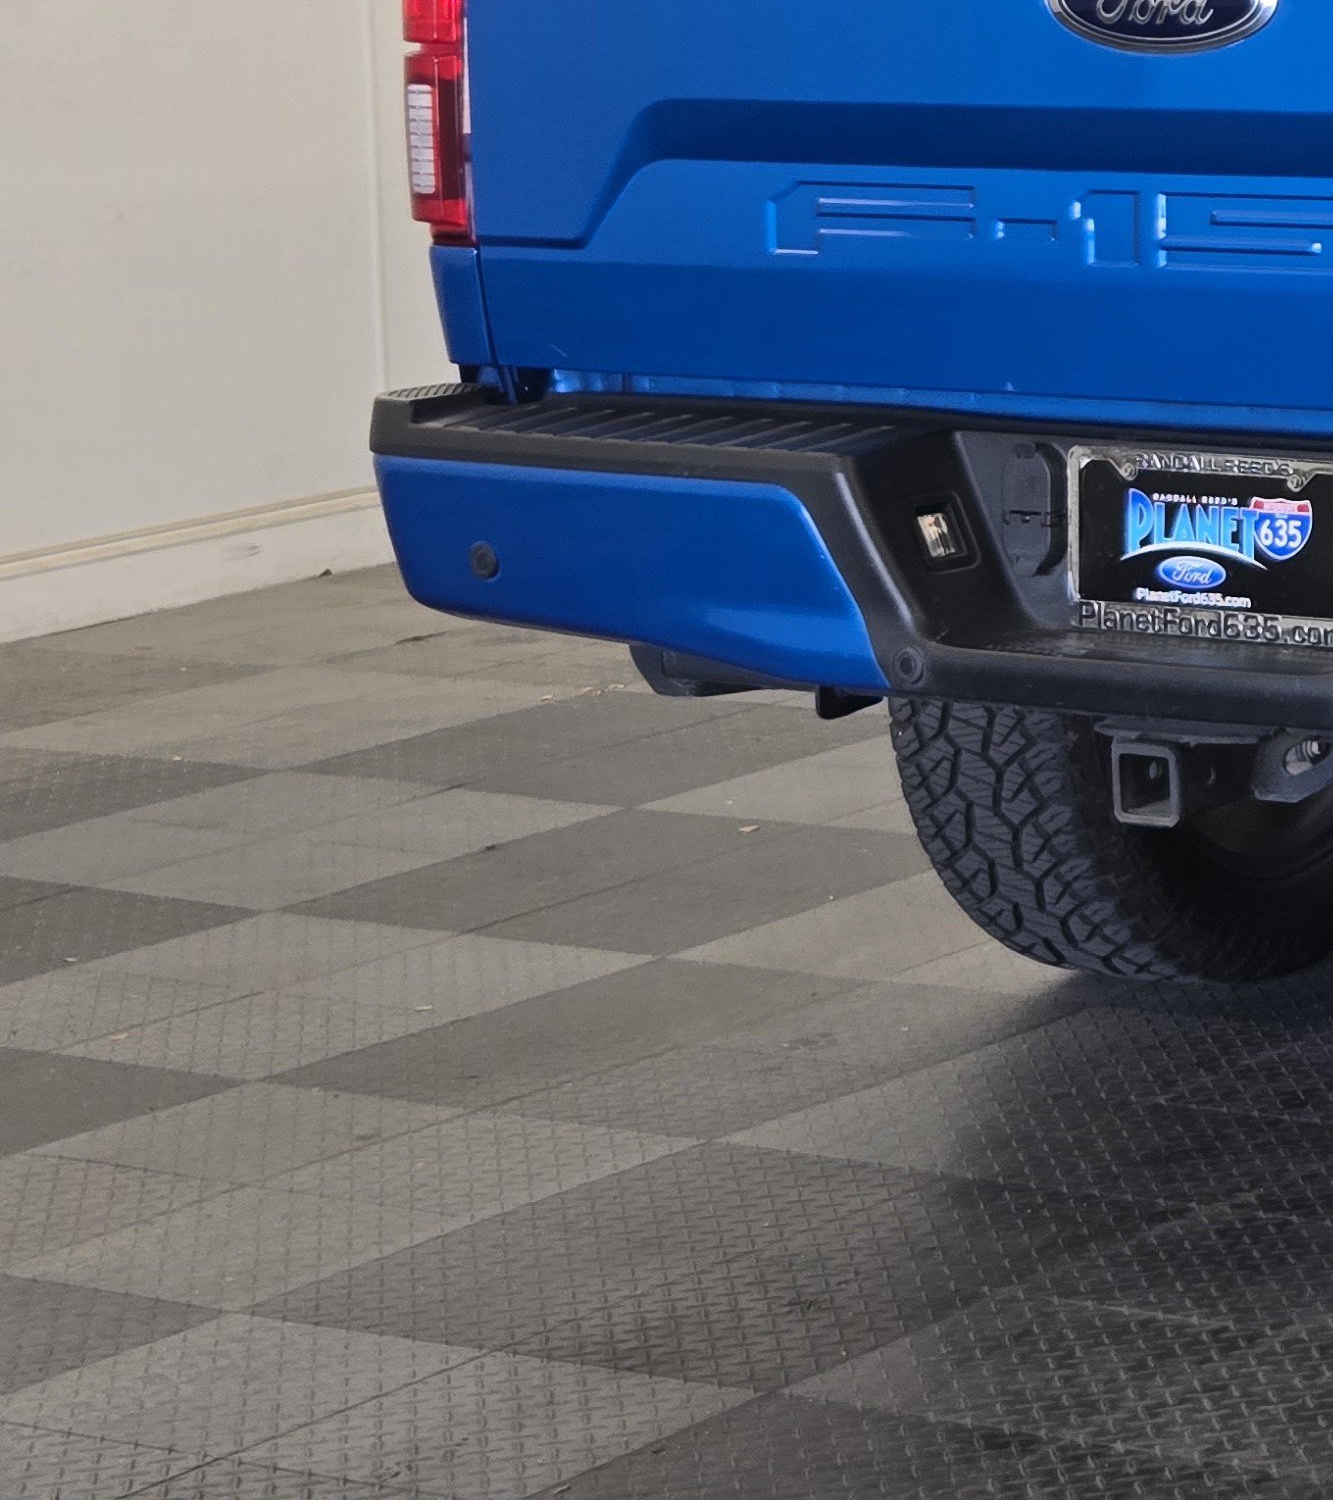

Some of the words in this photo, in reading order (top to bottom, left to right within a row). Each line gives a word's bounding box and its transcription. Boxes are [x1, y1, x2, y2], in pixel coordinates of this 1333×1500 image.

[1126, 488, 1260, 561] PLANET
[1260, 519, 1302, 548] 635
[1172, 562, 1213, 585] Ford
